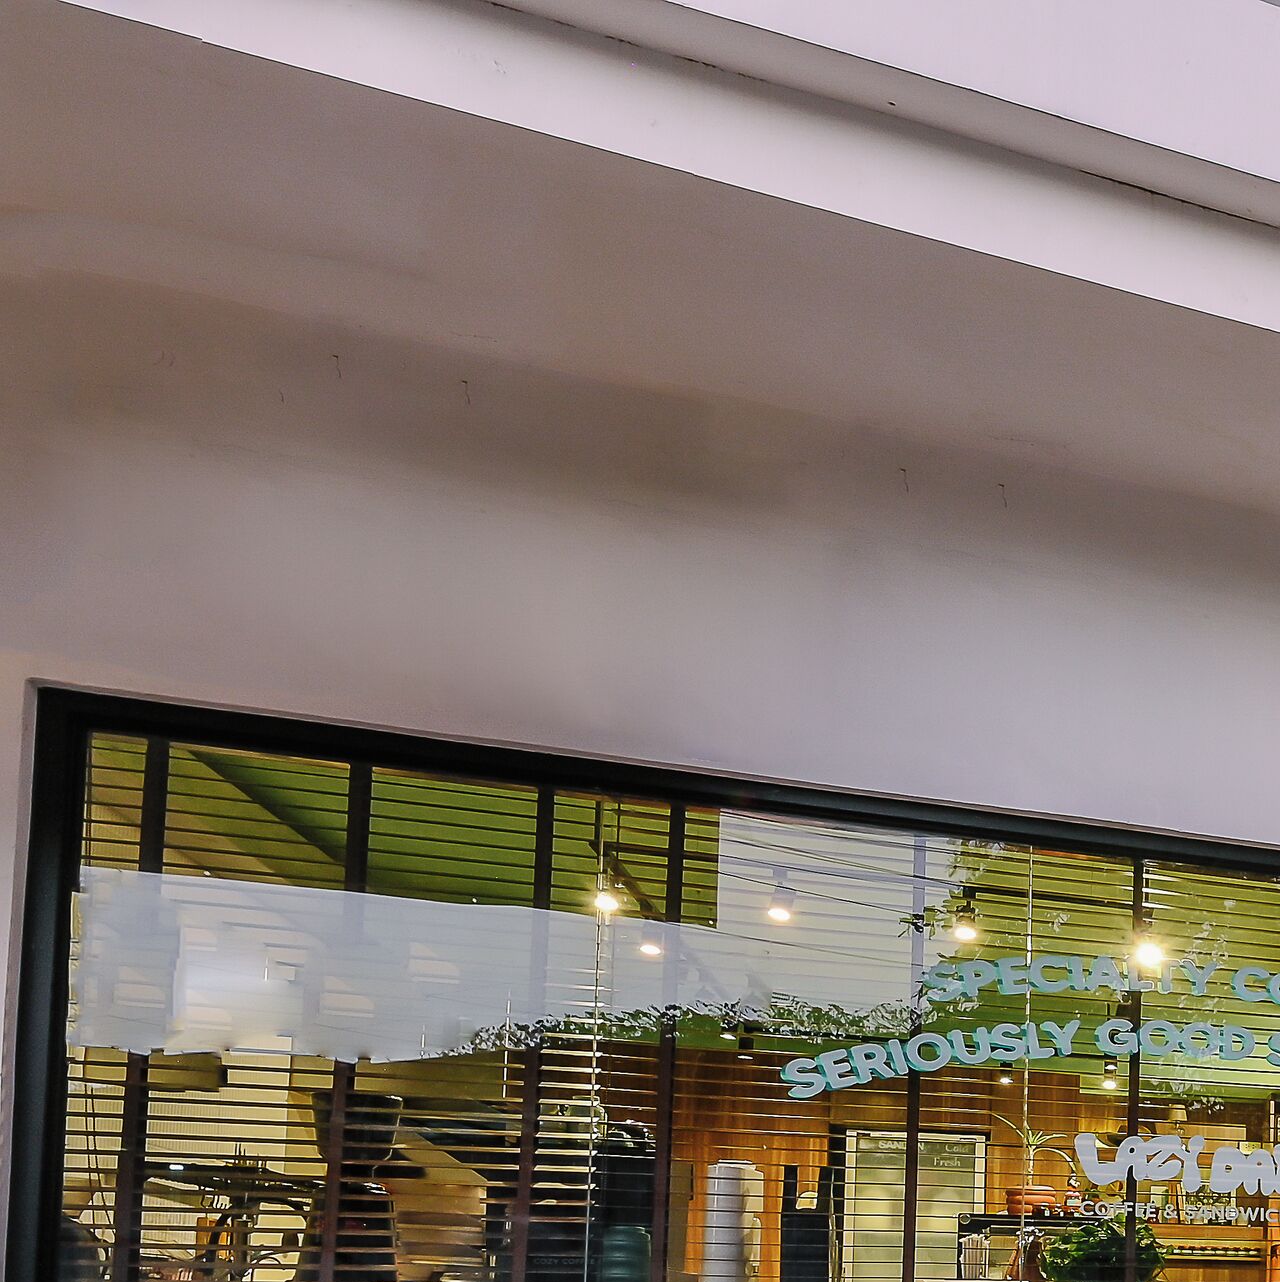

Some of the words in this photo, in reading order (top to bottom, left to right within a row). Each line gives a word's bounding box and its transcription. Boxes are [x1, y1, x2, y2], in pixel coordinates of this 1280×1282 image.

[924, 956, 1219, 1001] SPECIALTY
[780, 1019, 1081, 1099] SERIOUSLY
[1096, 1019, 1256, 1061] GOOD
[933, 1156, 961, 1167] Fresh
[1074, 1133, 1206, 1193] LAZY
[1079, 1200, 1157, 1219] COFFEE
[1163, 1203, 1179, 1219] &
